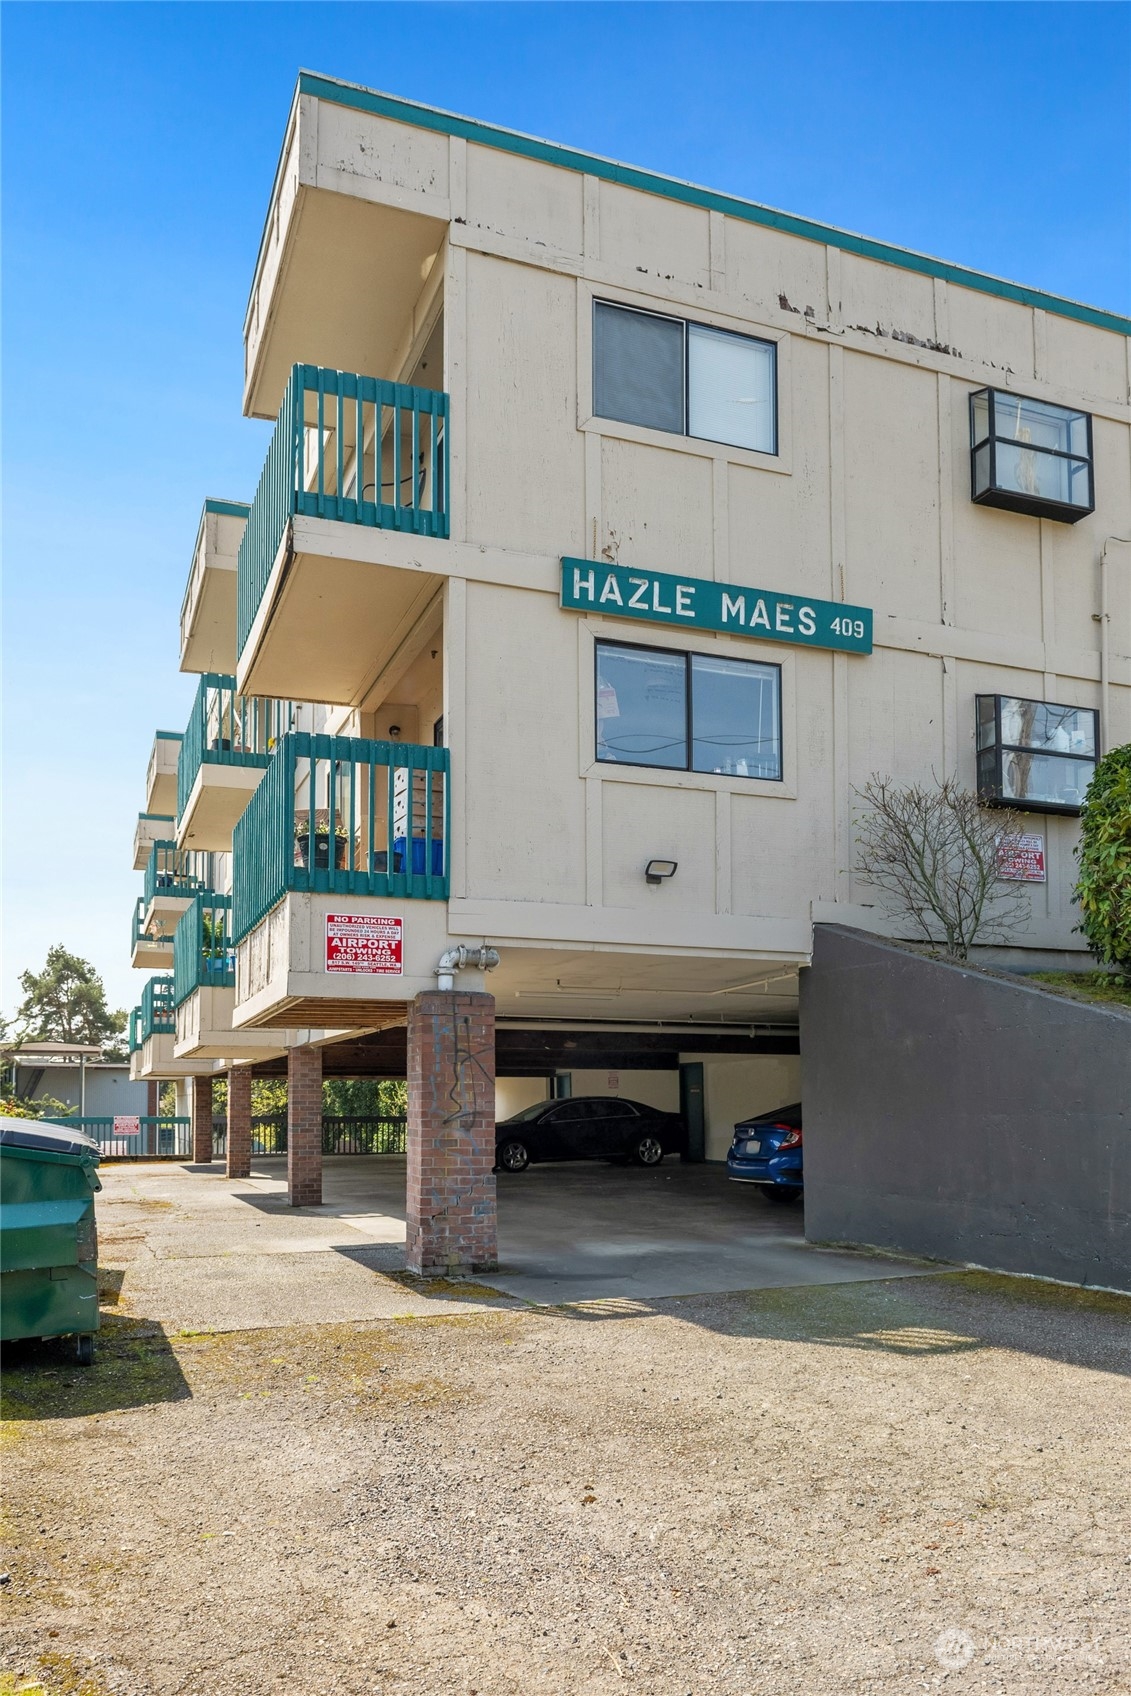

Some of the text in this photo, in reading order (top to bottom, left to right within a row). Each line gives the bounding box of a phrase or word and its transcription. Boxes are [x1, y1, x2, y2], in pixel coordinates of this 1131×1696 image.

[573, 567, 865, 638] HAZLE MAES 409
[351, 917, 395, 925] PARKING
[331, 938, 398, 949] AIRPORT
[338, 947, 391, 955] TOWING
